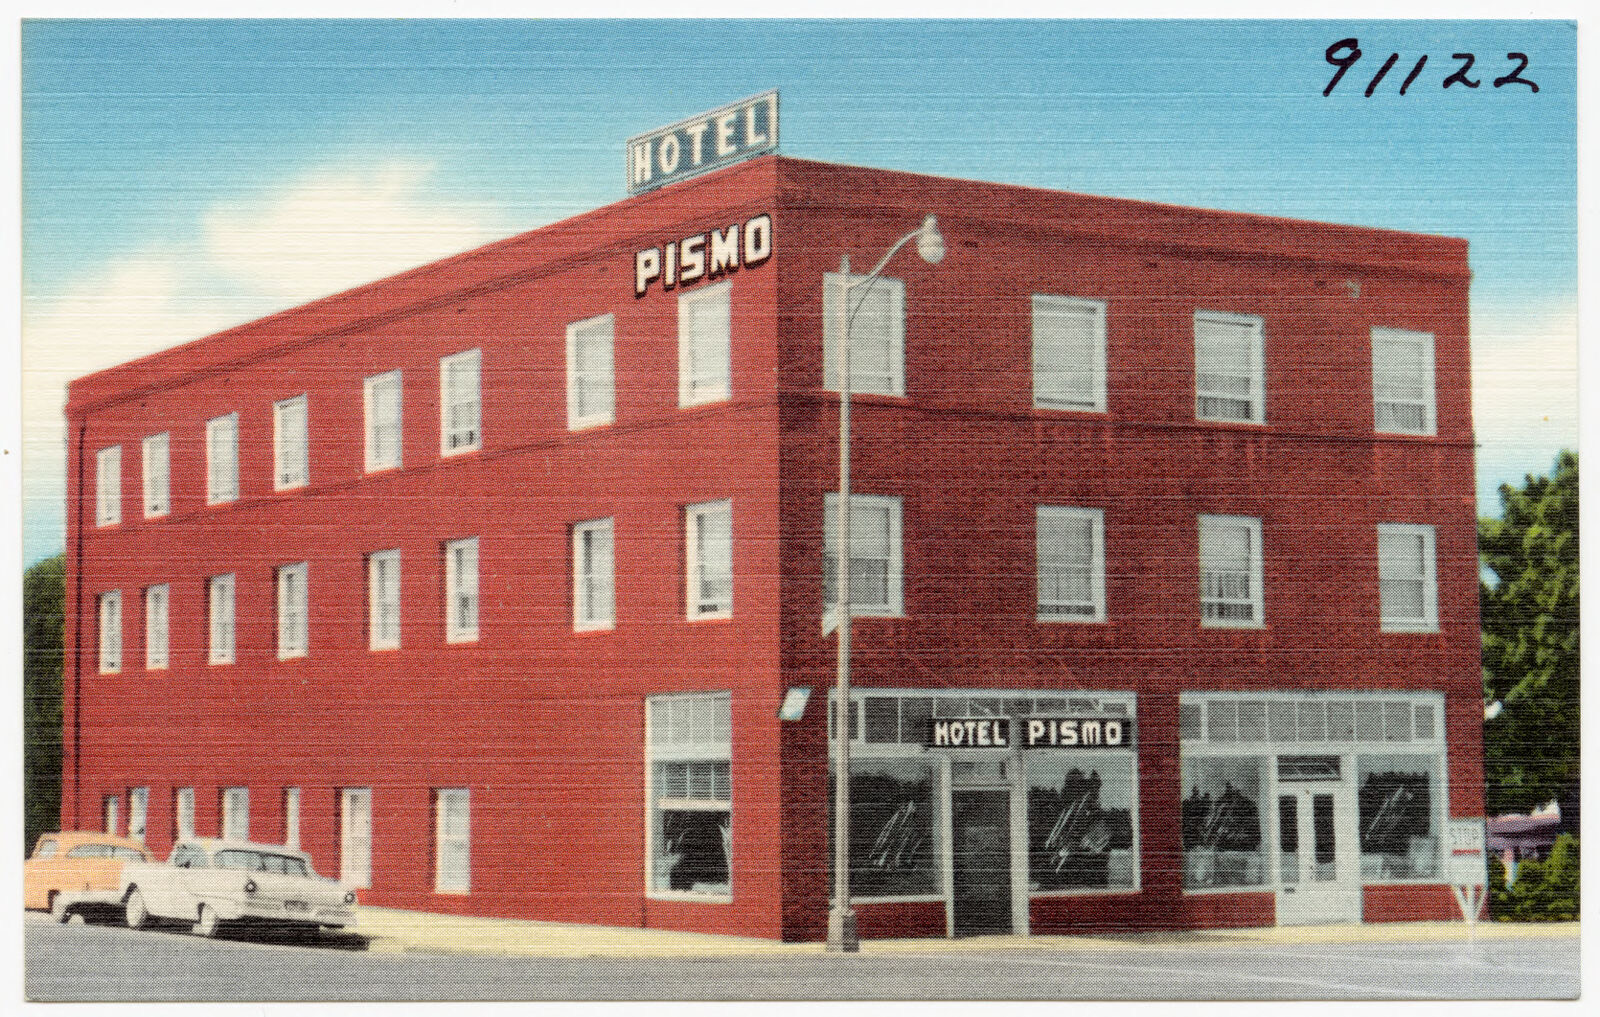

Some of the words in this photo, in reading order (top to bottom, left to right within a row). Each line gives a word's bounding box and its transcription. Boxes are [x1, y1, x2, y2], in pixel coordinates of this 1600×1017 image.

[1323, 38, 1539, 97] 91122
[634, 104, 767, 184] HOTEL
[635, 214, 770, 297] PISMO
[934, 720, 1006, 746] HOTEL
[1028, 720, 1123, 746] PISMO
